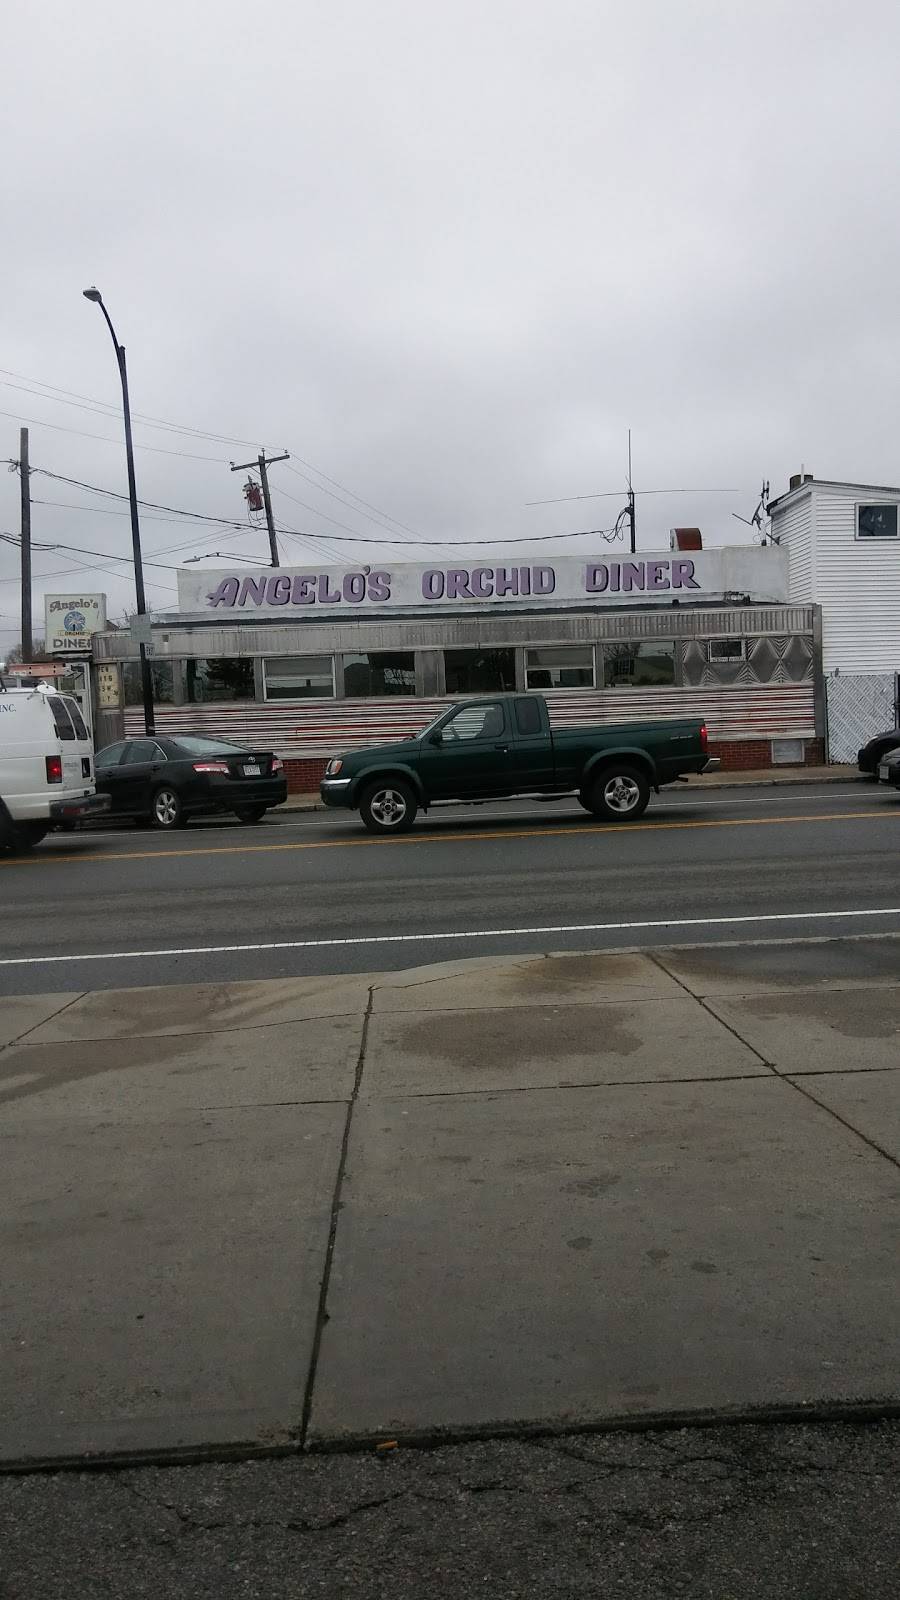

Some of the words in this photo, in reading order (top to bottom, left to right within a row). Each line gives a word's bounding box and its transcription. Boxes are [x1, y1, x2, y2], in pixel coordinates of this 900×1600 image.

[206, 565, 392, 607] ANGELO'S
[421, 566, 556, 600] ORCHID
[585, 559, 702, 593] DINER
[49, 598, 99, 612] Angelo's
